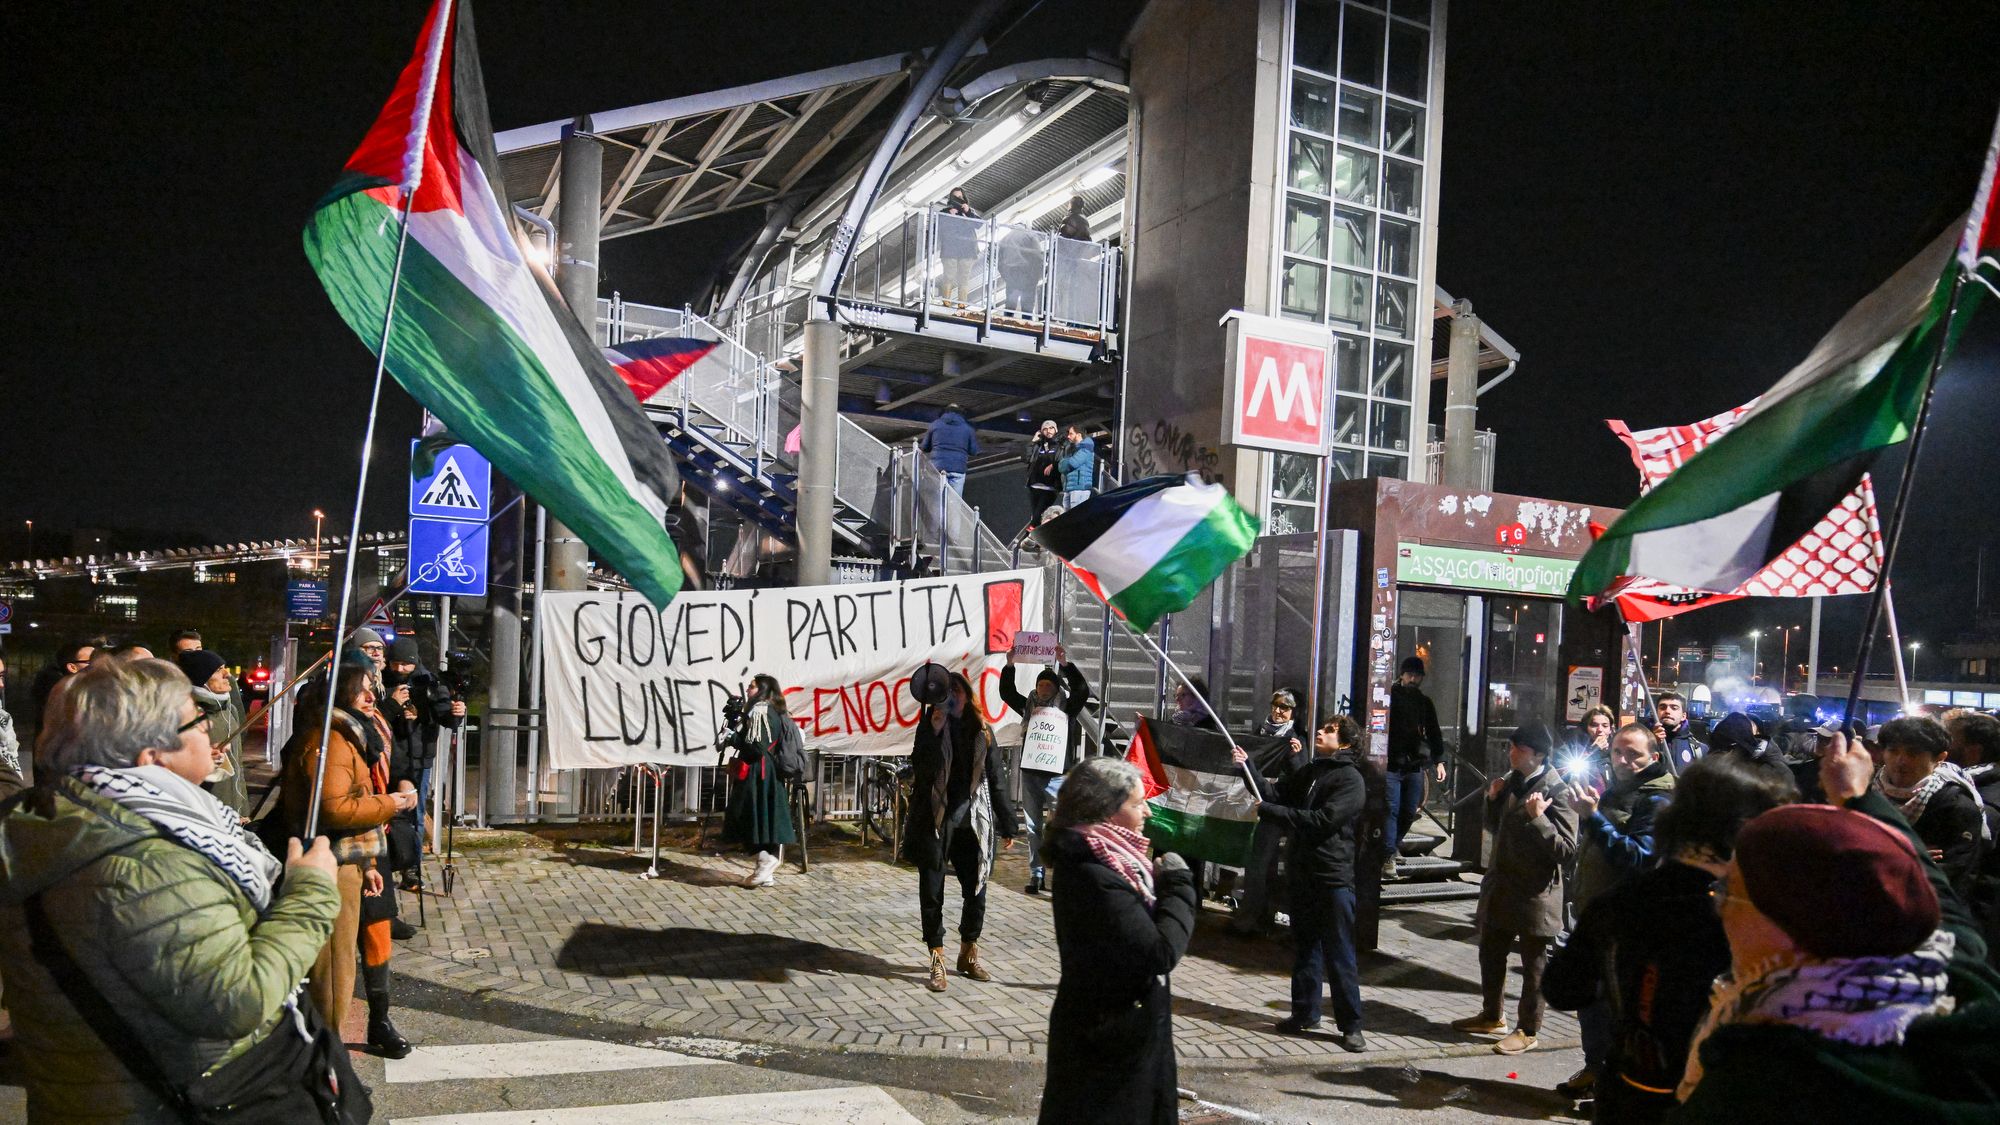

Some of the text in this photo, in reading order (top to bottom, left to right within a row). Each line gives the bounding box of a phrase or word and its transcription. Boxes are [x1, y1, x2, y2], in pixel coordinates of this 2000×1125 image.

[1246, 356, 1317, 427] M
[1514, 528, 1523, 540] G
[1410, 555, 1481, 580] ASSAGO
[1485, 563, 1563, 586] Milanofiori
[787, 579, 971, 660] PARTITA
[1027, 634, 1040, 643] NO
[1029, 732, 1062, 744] ATHLETES
